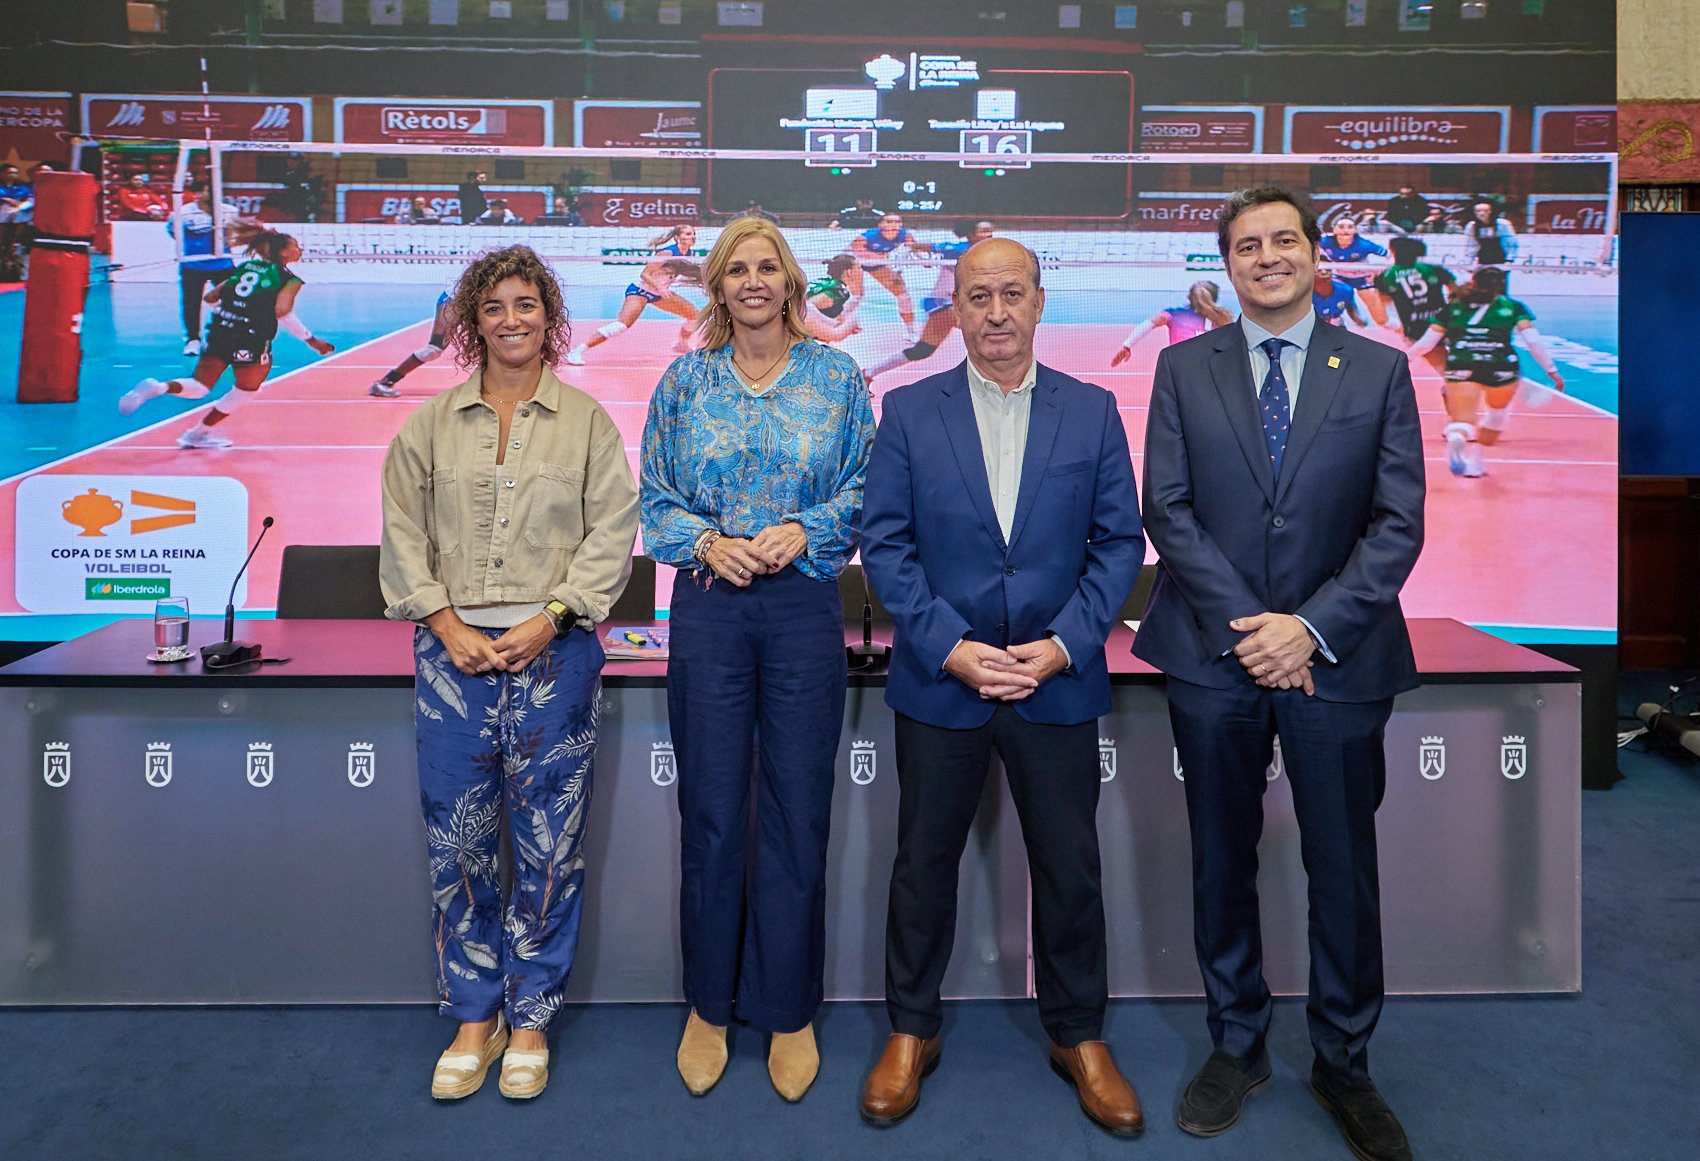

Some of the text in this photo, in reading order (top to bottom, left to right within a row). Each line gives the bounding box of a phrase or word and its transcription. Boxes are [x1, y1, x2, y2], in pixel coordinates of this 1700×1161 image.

[387, 110, 470, 130] Rètols
[1340, 116, 1452, 137] equilibra
[817, 133, 860, 153] 11
[971, 134, 1021, 163] 16
[629, 199, 699, 219] gelma
[235, 271, 259, 298] 8
[1395, 272, 1429, 299] 15
[1466, 302, 1491, 326] 7
[51, 548, 206, 559] COPA DE SM LA REINA
[85, 563, 172, 574] VOLEIBOL
[113, 584, 166, 594] Iberdrola
